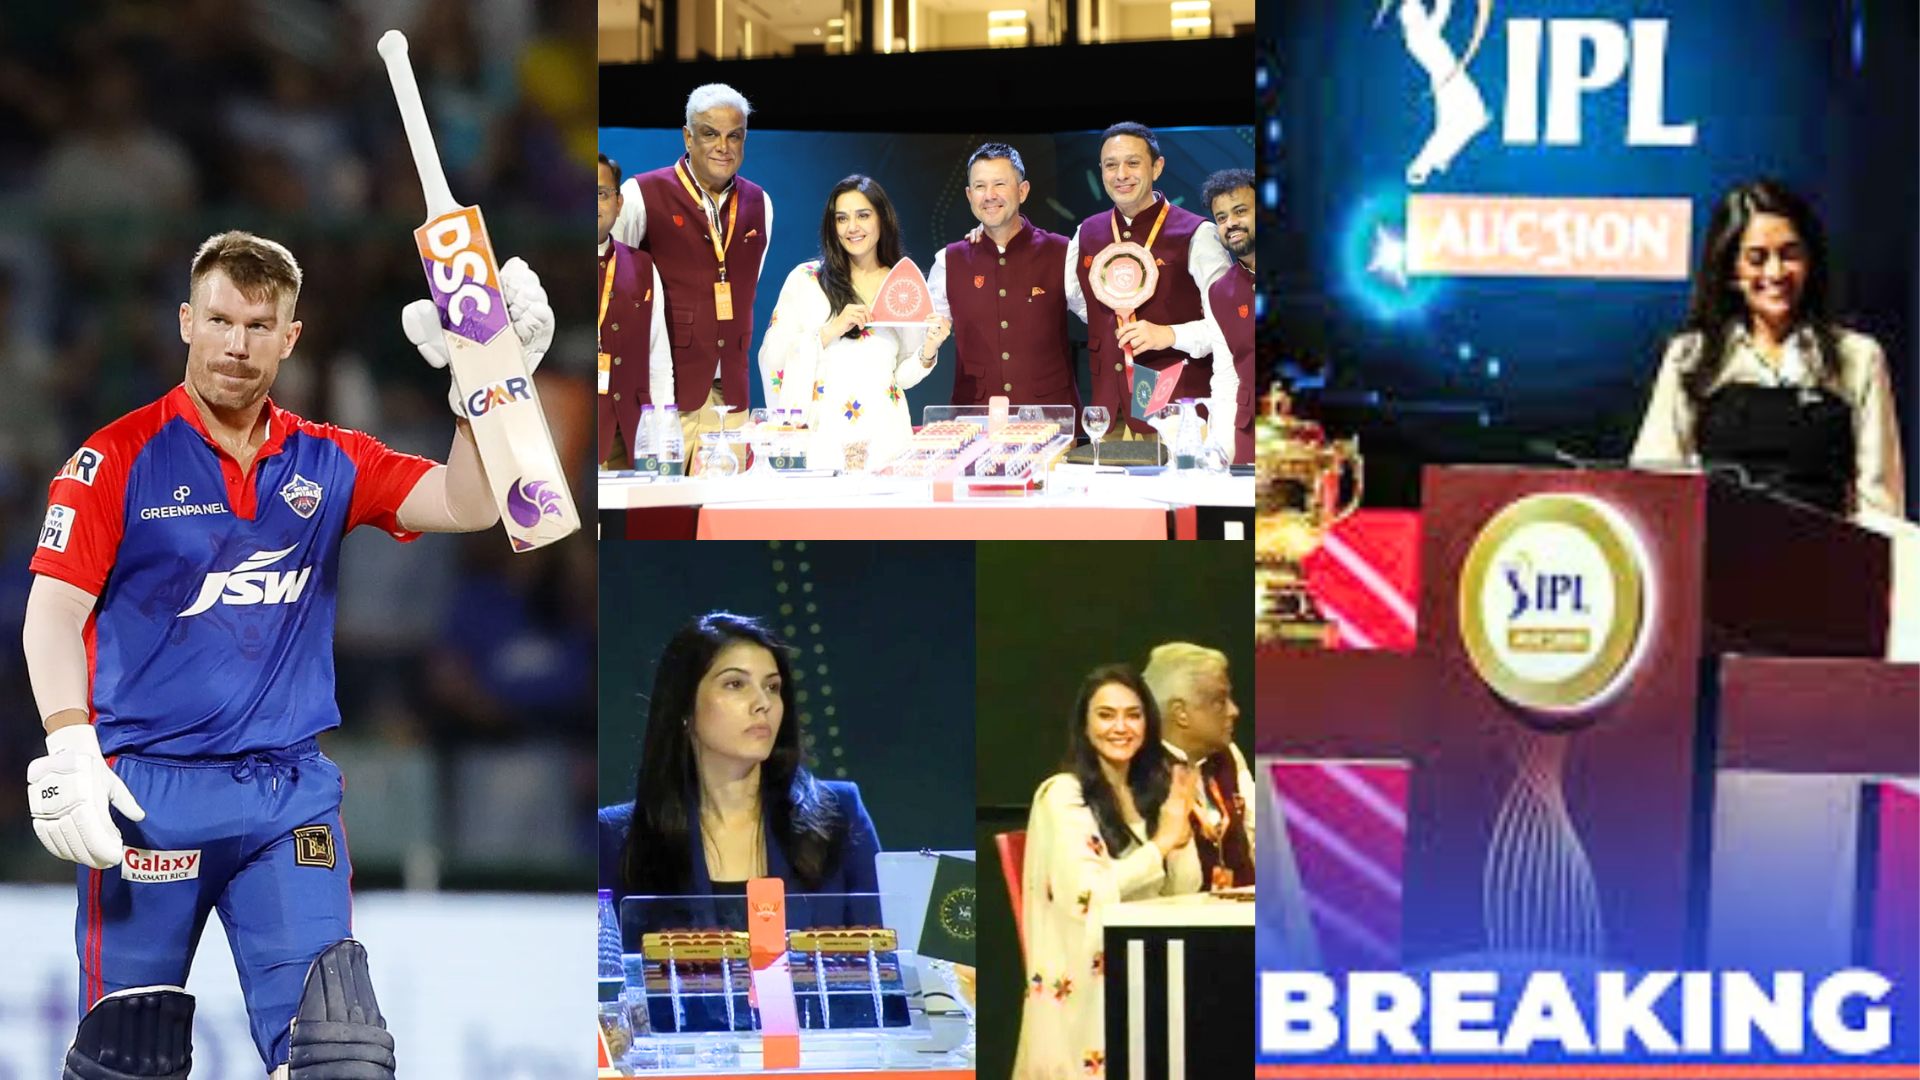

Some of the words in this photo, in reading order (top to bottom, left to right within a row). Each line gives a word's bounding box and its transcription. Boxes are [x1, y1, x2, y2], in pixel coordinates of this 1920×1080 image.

[1503, 18, 1697, 146] IPL
[426, 215, 491, 327] DSC
[468, 376, 531, 417] GMR
[140, 502, 229, 521] GREENPANEL
[176, 558, 313, 618] JSW
[1535, 572, 1586, 612] IPL
[41, 786, 60, 799] DSC
[124, 848, 199, 872] Galaxy
[131, 872, 168, 881] BASMATI
[170, 871, 190, 880] RICE
